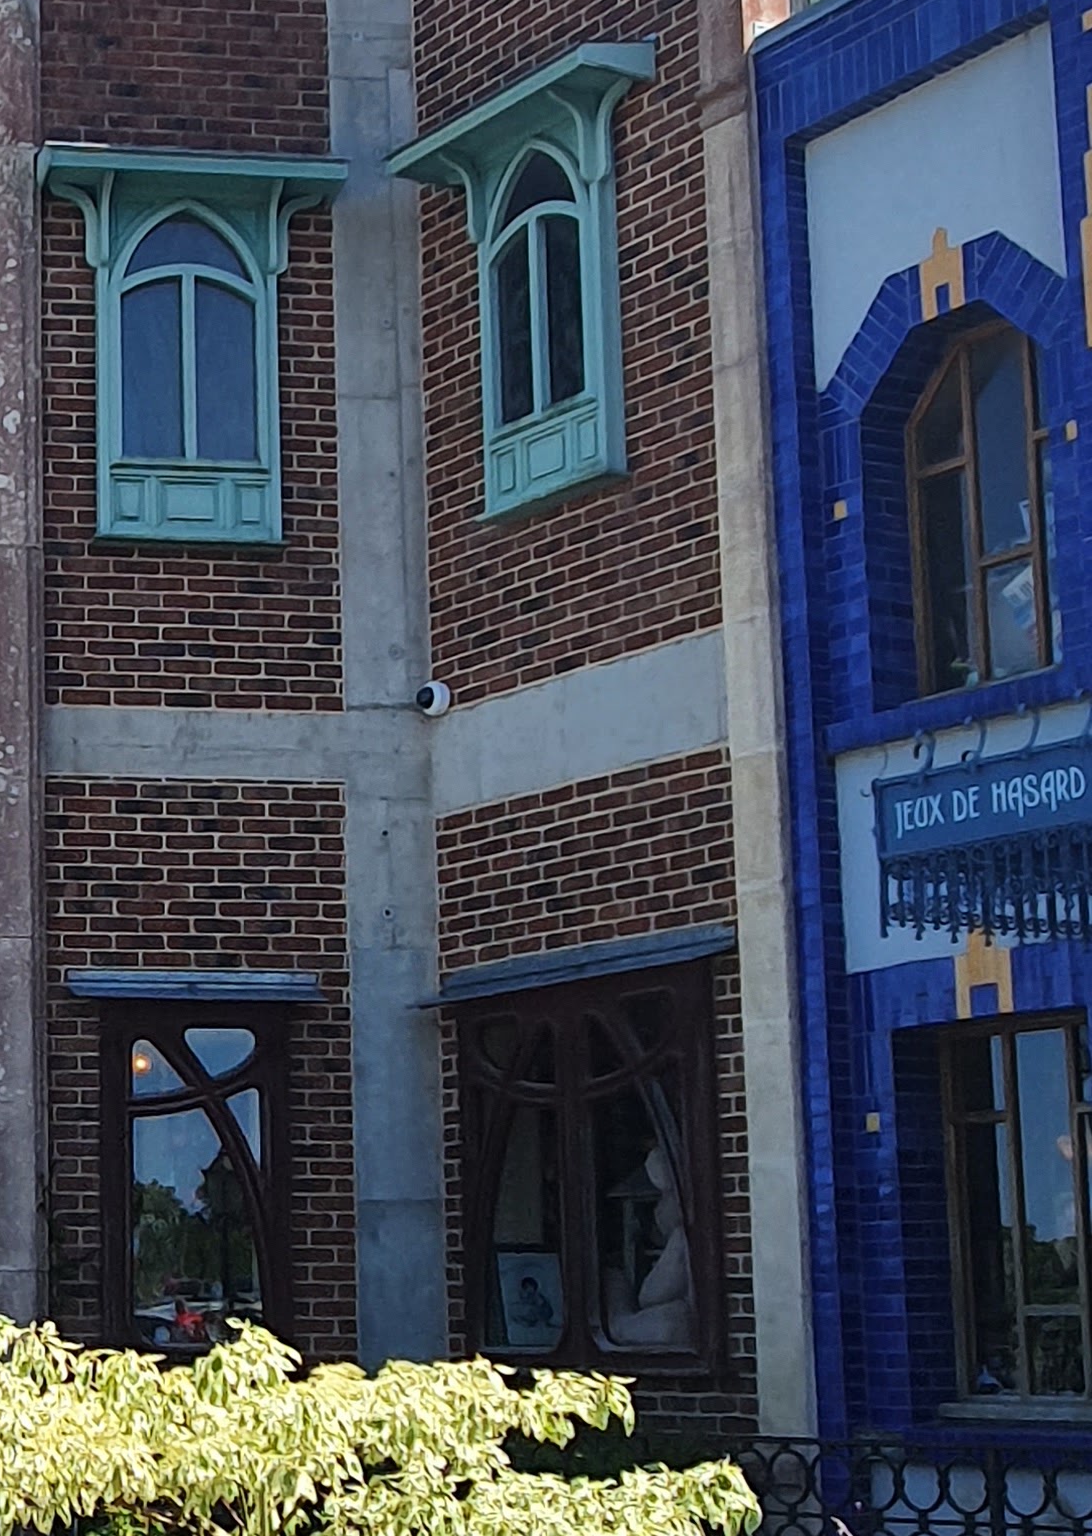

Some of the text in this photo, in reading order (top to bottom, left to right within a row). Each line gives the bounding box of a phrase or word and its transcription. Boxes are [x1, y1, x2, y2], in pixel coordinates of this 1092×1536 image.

[894, 766, 1086, 839] JEUX DE HASARD
